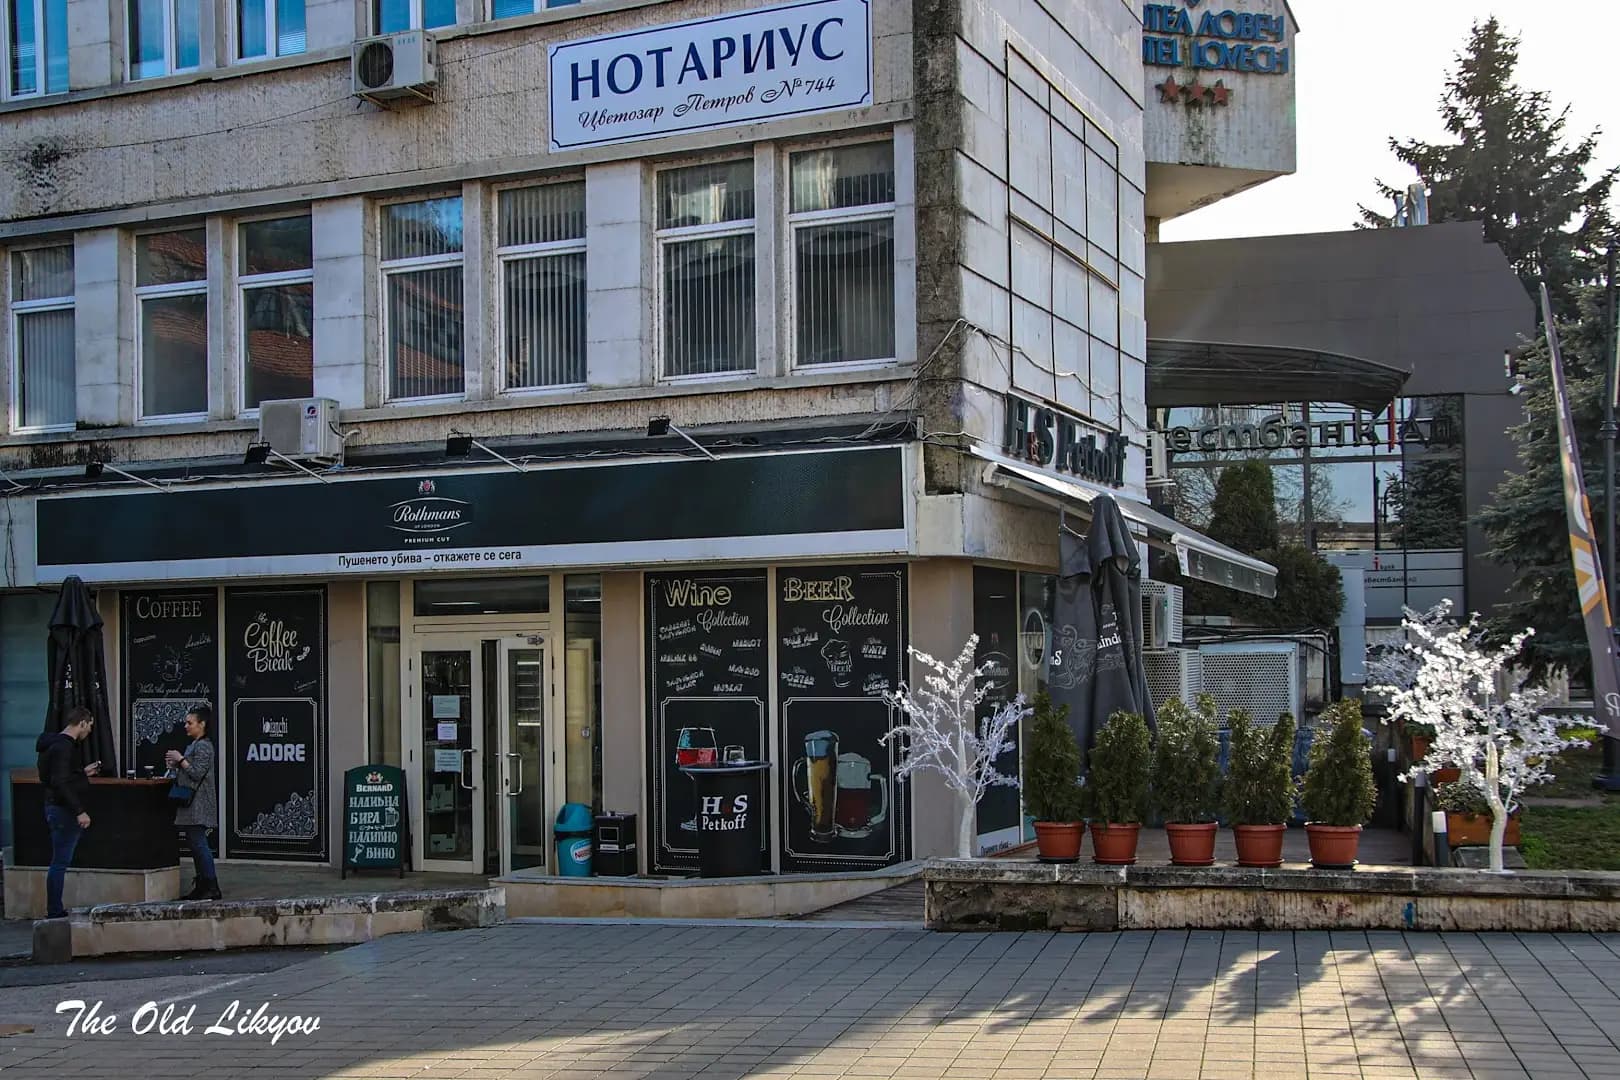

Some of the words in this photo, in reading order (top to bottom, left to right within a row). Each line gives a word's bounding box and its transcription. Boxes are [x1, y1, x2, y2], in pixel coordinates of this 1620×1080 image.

[1143, 4, 1193, 34] ТЕЛ
[1196, 9, 1284, 42] ЛОВЕЧ
[570, 17, 845, 102] НОТАРИУС
[1190, 41, 1289, 74] LOVECH
[578, 104, 665, 132] Цветозар
[672, 83, 755, 119] Петров
[393, 504, 462, 523] Rothmans
[404, 536, 435, 544] PREMIUM
[338, 555, 389, 567] Пушенето
[390, 551, 422, 567] убива
[433, 552, 481, 562] откажете
[483, 551, 496, 560] се
[498, 549, 522, 561] сега
[664, 579, 732, 607] Wine
[784, 576, 855, 602] BEER
[136, 596, 202, 619] COFFEE
[822, 605, 890, 634] Collection
[696, 609, 750, 634] Collection
[244, 620, 298, 658] Coffee
[247, 648, 294, 672] Break
[246, 743, 306, 761] ADORE
[356, 783, 393, 793] BERNARD
[350, 811, 380, 825] БИРА
[702, 814, 747, 831] Petkoff
[366, 847, 396, 860] ВИНО
